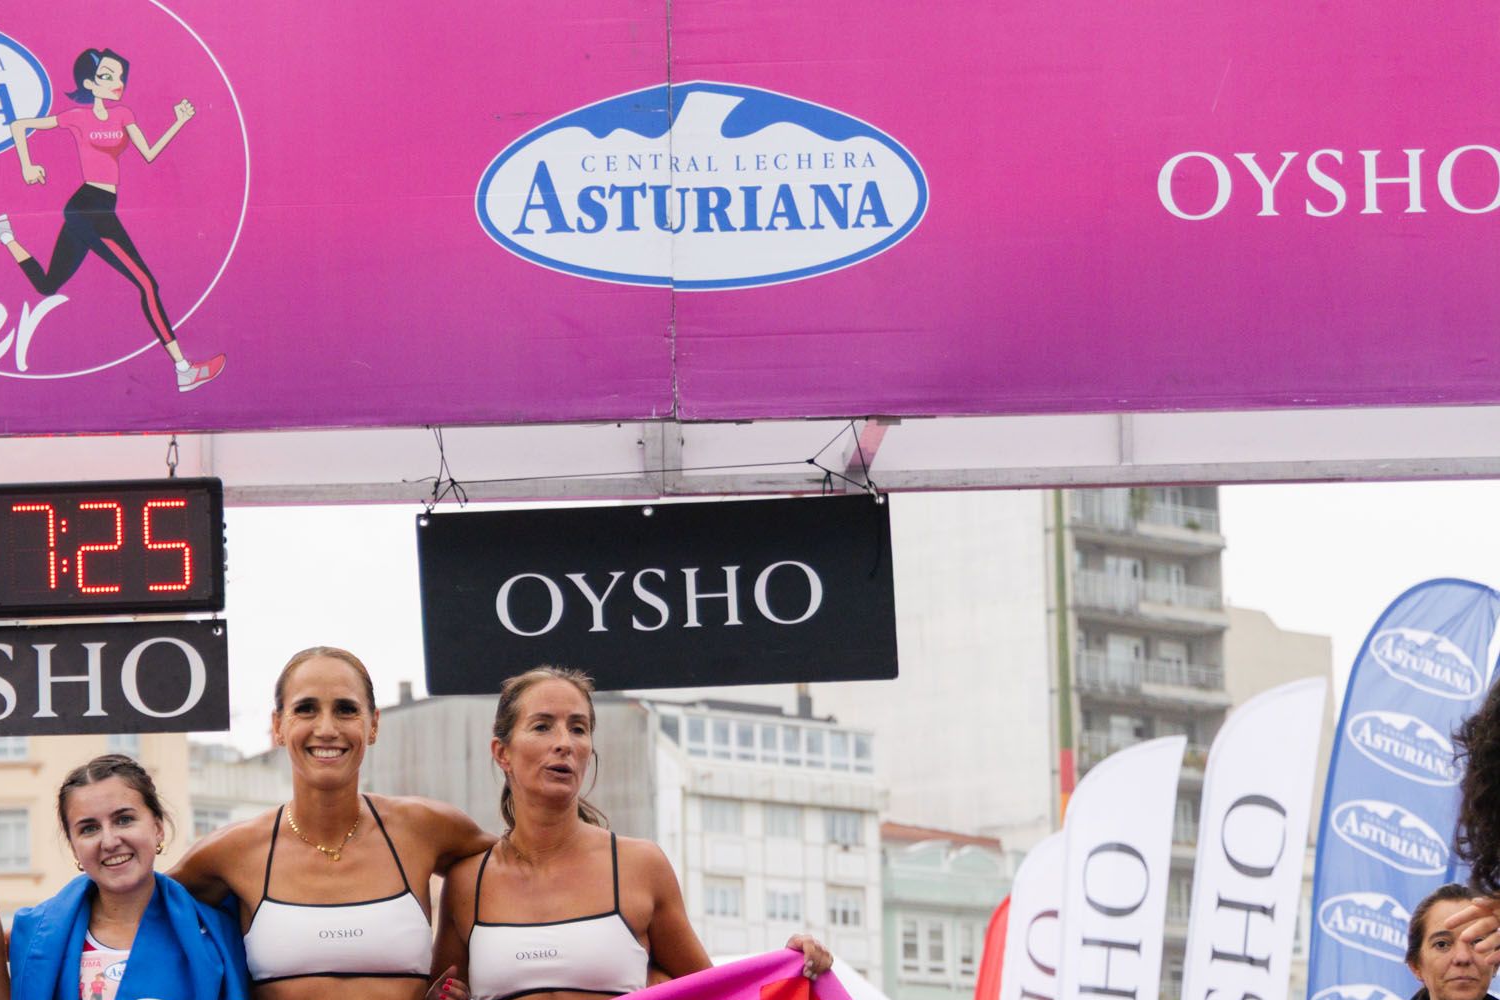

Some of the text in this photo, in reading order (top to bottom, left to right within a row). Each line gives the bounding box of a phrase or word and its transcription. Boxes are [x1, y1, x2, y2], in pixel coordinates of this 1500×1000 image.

[89, 130, 124, 140] OYSHO
[581, 151, 877, 173] CENTRAL LECHERA
[512, 160, 894, 235] ASTURIANA
[1157, 144, 1500, 220] OYSHO
[496, 560, 823, 637] OYSHO
[1380, 637, 1472, 694] ASTURIANA
[1341, 810, 1442, 869] ASTURIANA
[318, 928, 364, 940] OYSHO
[515, 948, 559, 962] OYSHO
